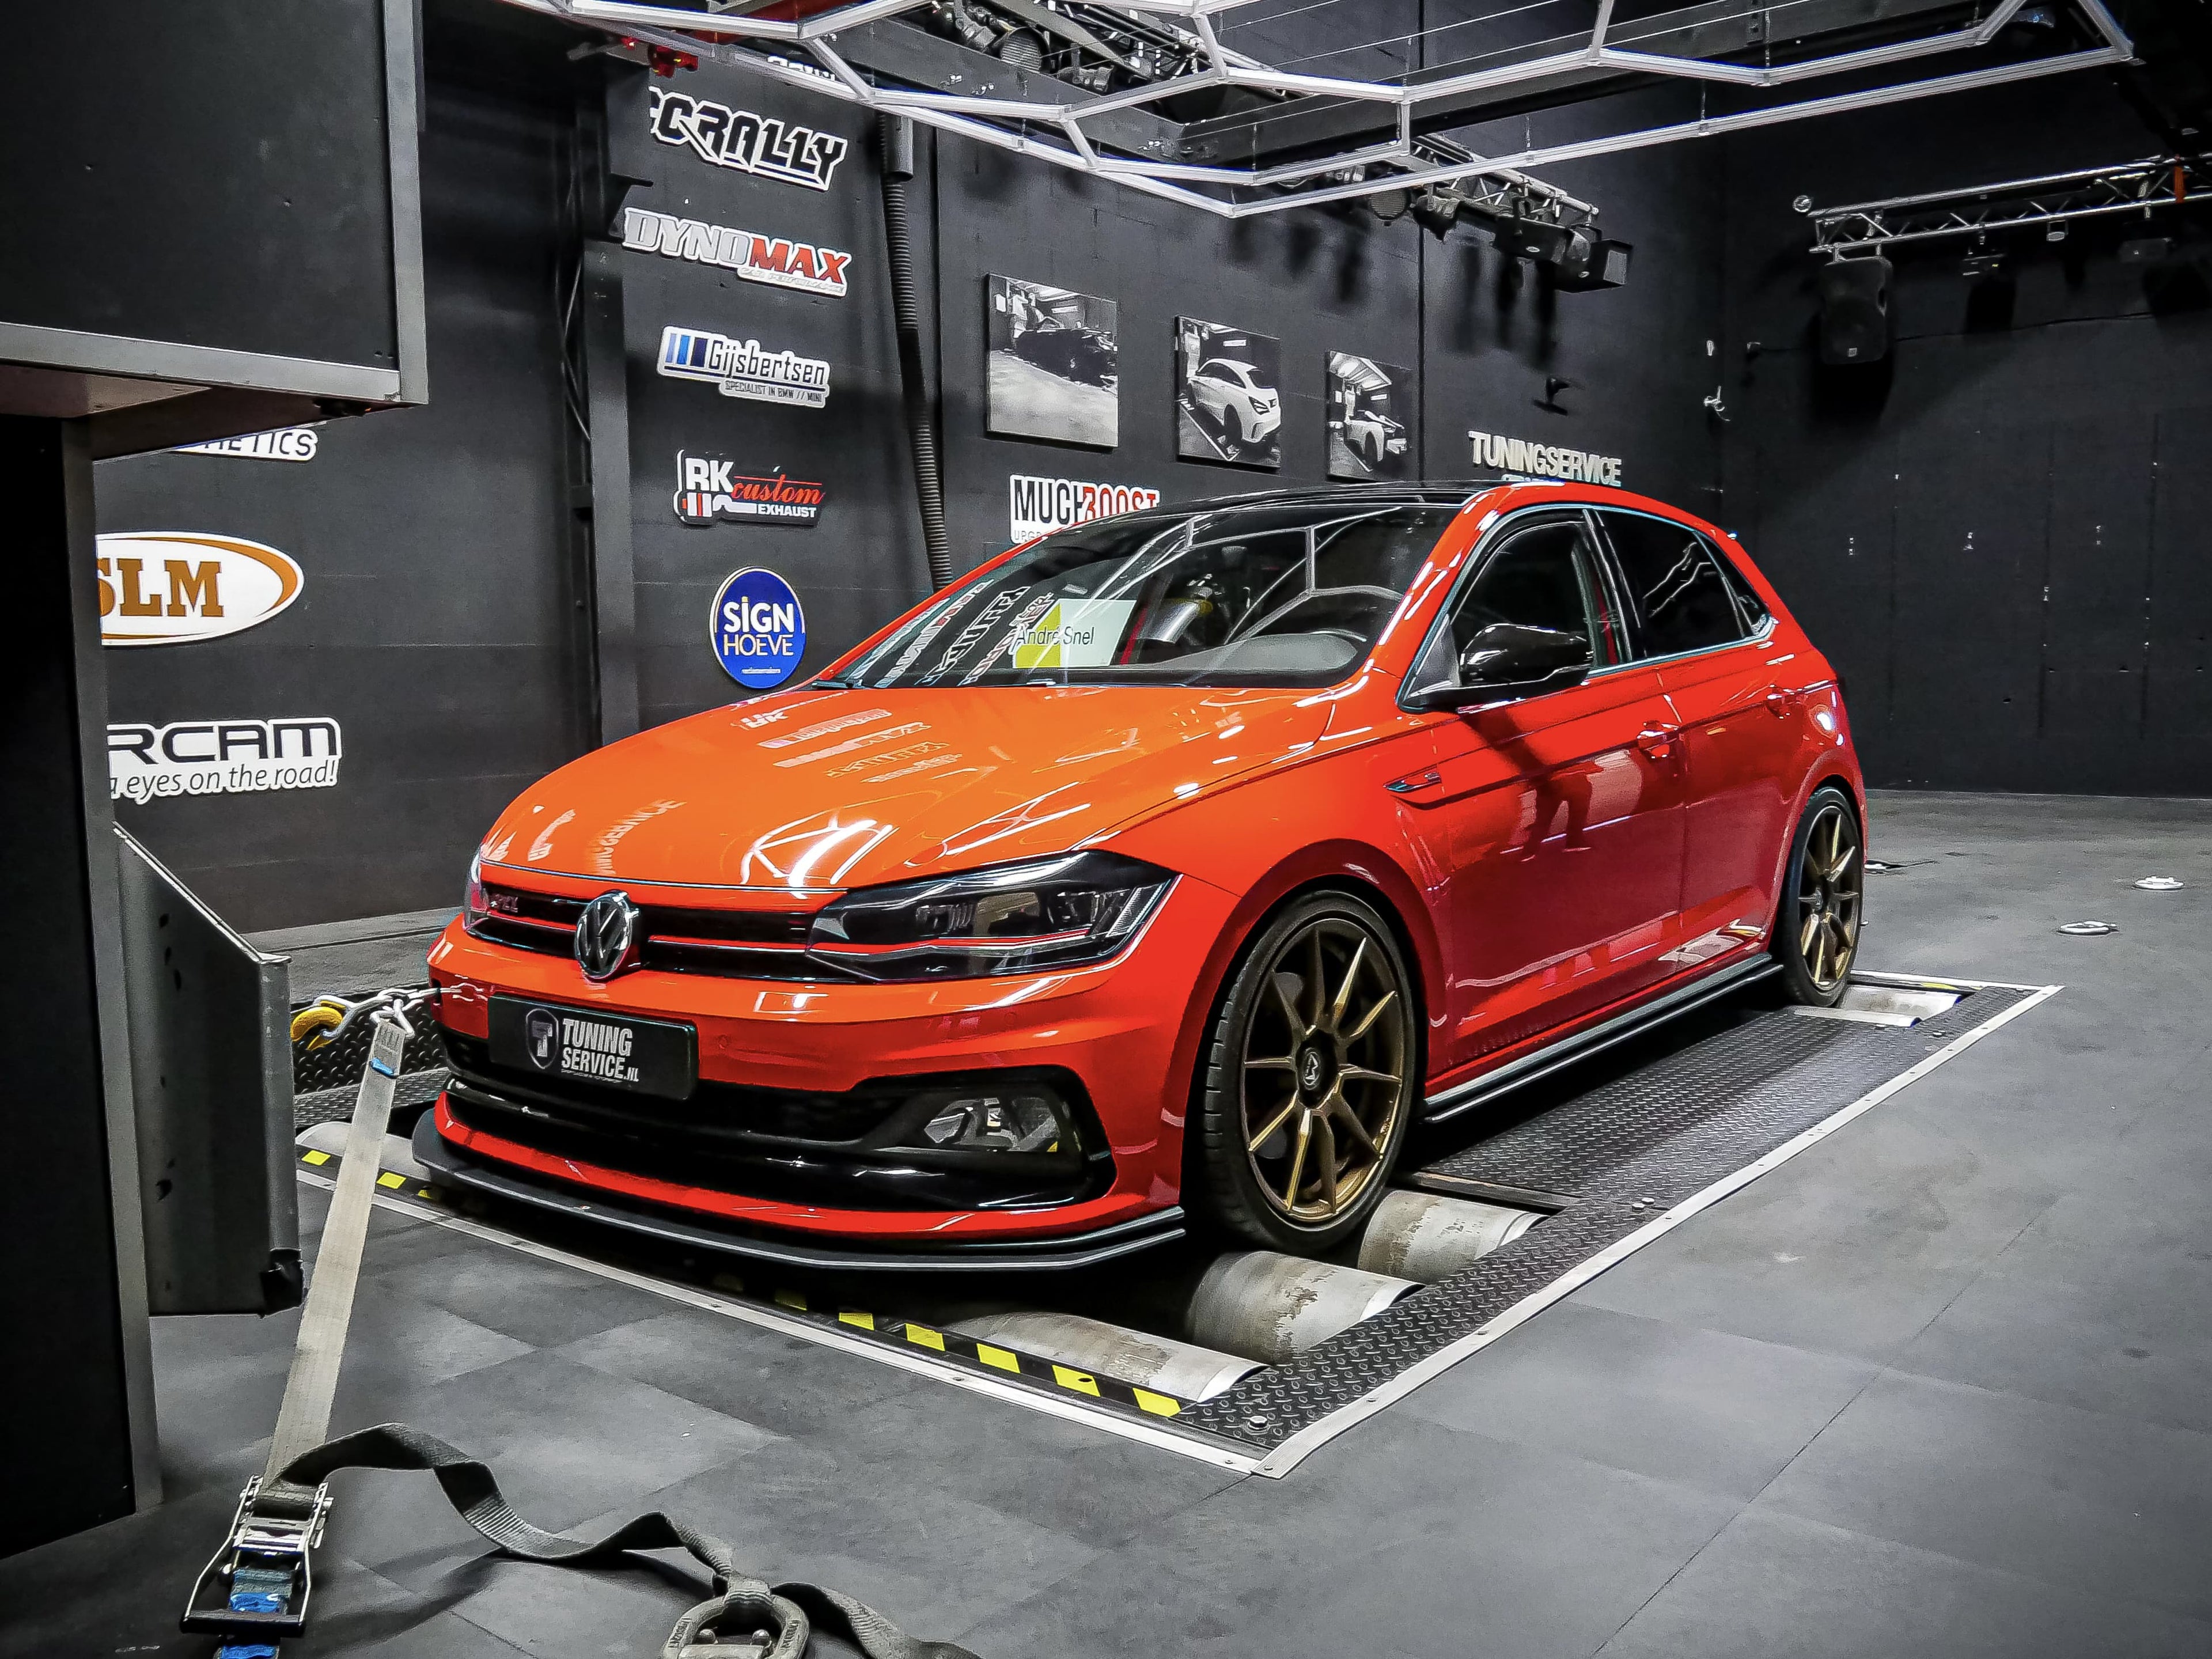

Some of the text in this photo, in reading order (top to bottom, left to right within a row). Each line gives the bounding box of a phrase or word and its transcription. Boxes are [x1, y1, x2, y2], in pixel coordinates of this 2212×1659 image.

[626, 211, 847, 284] DYNOMAX
[709, 339, 825, 385] Gijsbertsen
[685, 458, 826, 505] RK custom
[757, 503, 817, 518] EXHAUST
[723, 634, 794, 656] HOEVE
[1063, 626, 1094, 645] Snel
[126, 773, 181, 800] eyes
[190, 772, 221, 790] on
[230, 763, 267, 789] the
[275, 760, 335, 786] road!
[563, 1018, 633, 1057] TUNING
